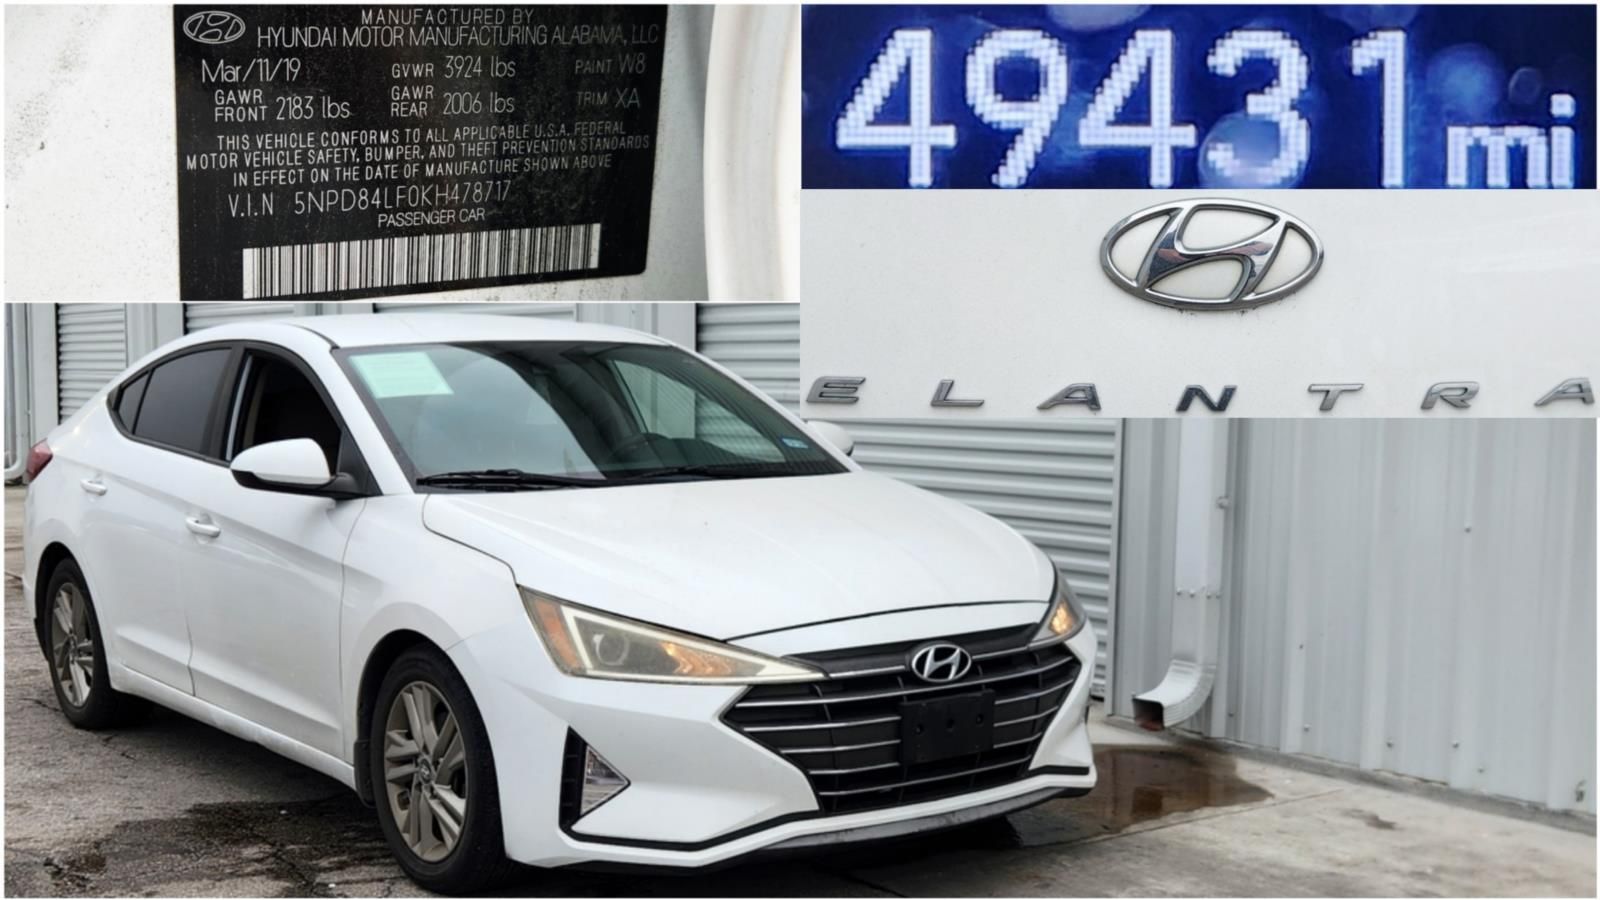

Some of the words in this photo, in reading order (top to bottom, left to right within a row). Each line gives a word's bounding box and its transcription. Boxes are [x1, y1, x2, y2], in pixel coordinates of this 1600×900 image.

[361, 8, 506, 25] MANUFACTURED
[512, 8, 534, 25] BY
[257, 26, 337, 48] HYUNDAI
[342, 26, 405, 48] MOTOR
[409, 25, 548, 47] MANUFACTURING
[551, 24, 628, 46] ALABAMA,
[631, 23, 660, 45] LLC
[201, 57, 301, 83] Mar/11/19
[391, 63, 435, 79] GVWR
[443, 55, 483, 79] 3924
[490, 55, 517, 78] lbs
[574, 58, 613, 75] PAINT
[618, 52, 647, 74] W8
[214, 88, 263, 106] GAWR
[390, 85, 435, 101] GAWR
[390, 101, 428, 118] REAR
[442, 92, 483, 115] 2006
[489, 91, 516, 114] lbs
[576, 91, 608, 107] TRIM
[614, 87, 641, 109] XA
[214, 105, 268, 123] FRONT
[275, 95, 314, 121] 2183
[321, 95, 351, 120] lbs
[836, 28, 1407, 189] 49431
[217, 135, 250, 151] THIS
[256, 132, 315, 150] VEHICLE
[320, 129, 400, 147] CONFORMS
[405, 128, 421, 143] TO
[426, 127, 448, 142] ALL
[453, 124, 529, 141] APPLICABLE
[534, 123, 571, 139] U.S.A.
[574, 121, 627, 136] FEDERAL
[186, 153, 238, 170] MOTOR
[244, 150, 302, 168] VEHICLE
[307, 147, 360, 165] SAFETY,
[365, 145, 425, 162] BUMPER,
[429, 143, 455, 159] AND
[461, 141, 497, 157] THEFT
[502, 138, 576, 155] PREVENTION
[580, 135, 650, 151] STANDARDS
[233, 171, 248, 187] IN
[253, 168, 305, 186] EFFECT
[310, 167, 329, 183] ON
[335, 166, 360, 182] THE
[365, 164, 398, 180] DATE
[403, 163, 420, 178] OF
[425, 159, 519, 177] MANUFACTURE
[523, 156, 569, 173] SHOWN
[572, 153, 612, 169] ABOVE
[228, 192, 273, 217] V.I.N
[294, 179, 512, 215] 5NPD84LF0KH478717
[378, 209, 456, 228] PASSENGER
[458, 207, 486, 223] CAR
[806, 376, 1594, 413] ELANTRA
